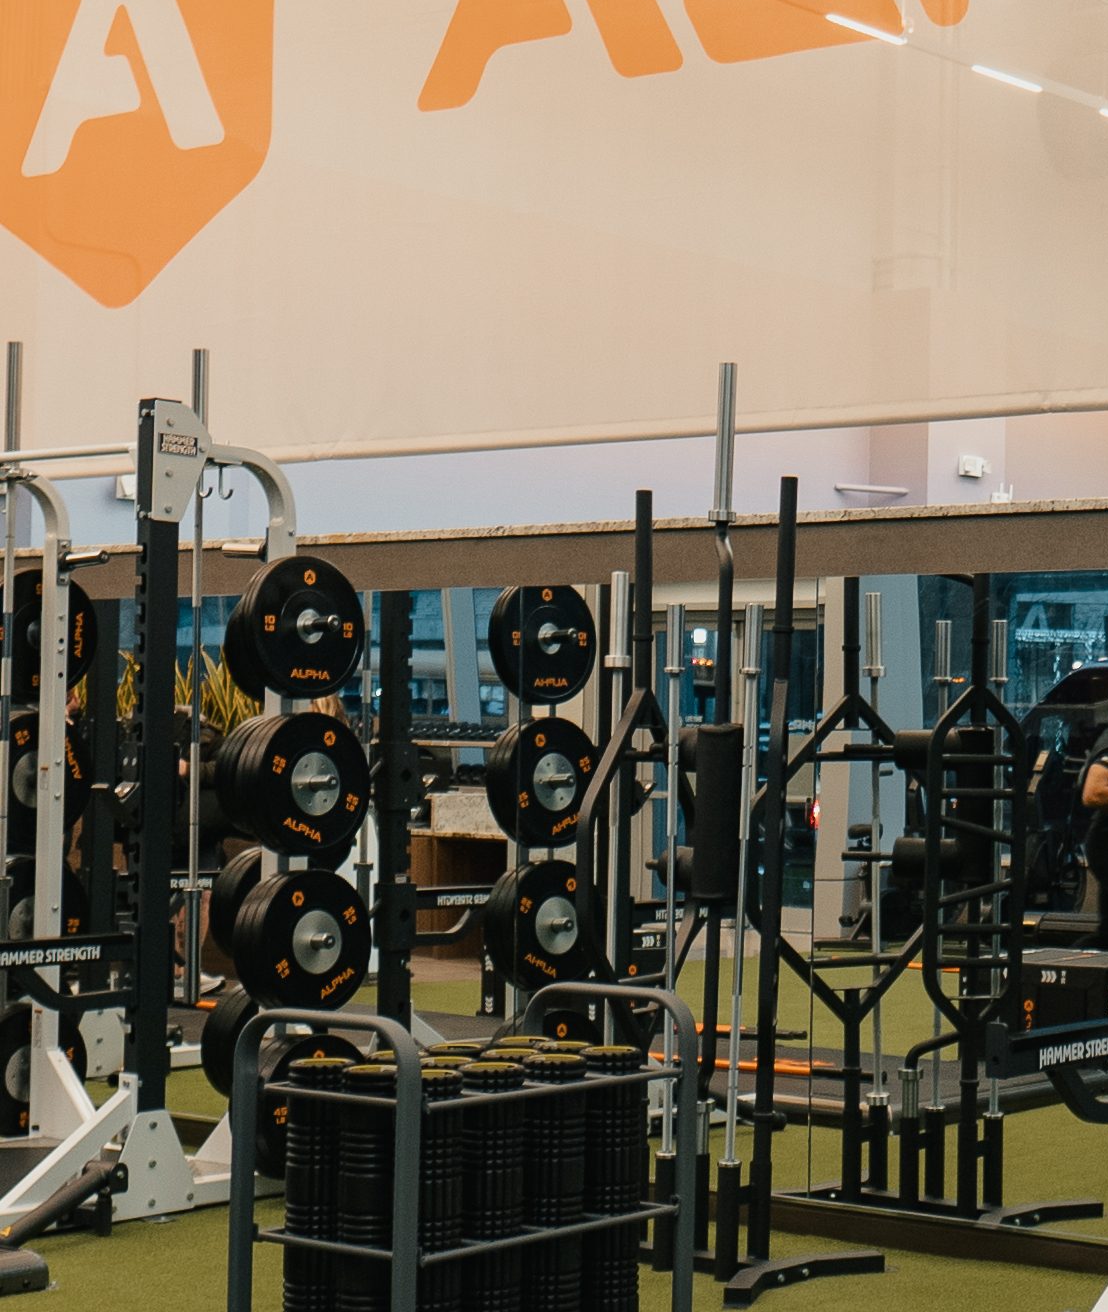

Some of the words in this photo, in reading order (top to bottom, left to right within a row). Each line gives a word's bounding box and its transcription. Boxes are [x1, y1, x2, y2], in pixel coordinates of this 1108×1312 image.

[264, 615, 276, 624] 10
[343, 622, 353, 630] 10
[290, 668, 331, 681] ALPHA
[283, 817, 323, 843] ALPHA
[0, 949, 44, 967] AMMER
[45, 944, 101, 964] STRENGTH
[320, 967, 355, 1000] ALPHA
[1039, 1043, 1085, 1070] HAMMER
[273, 1106, 289, 1116] 45
